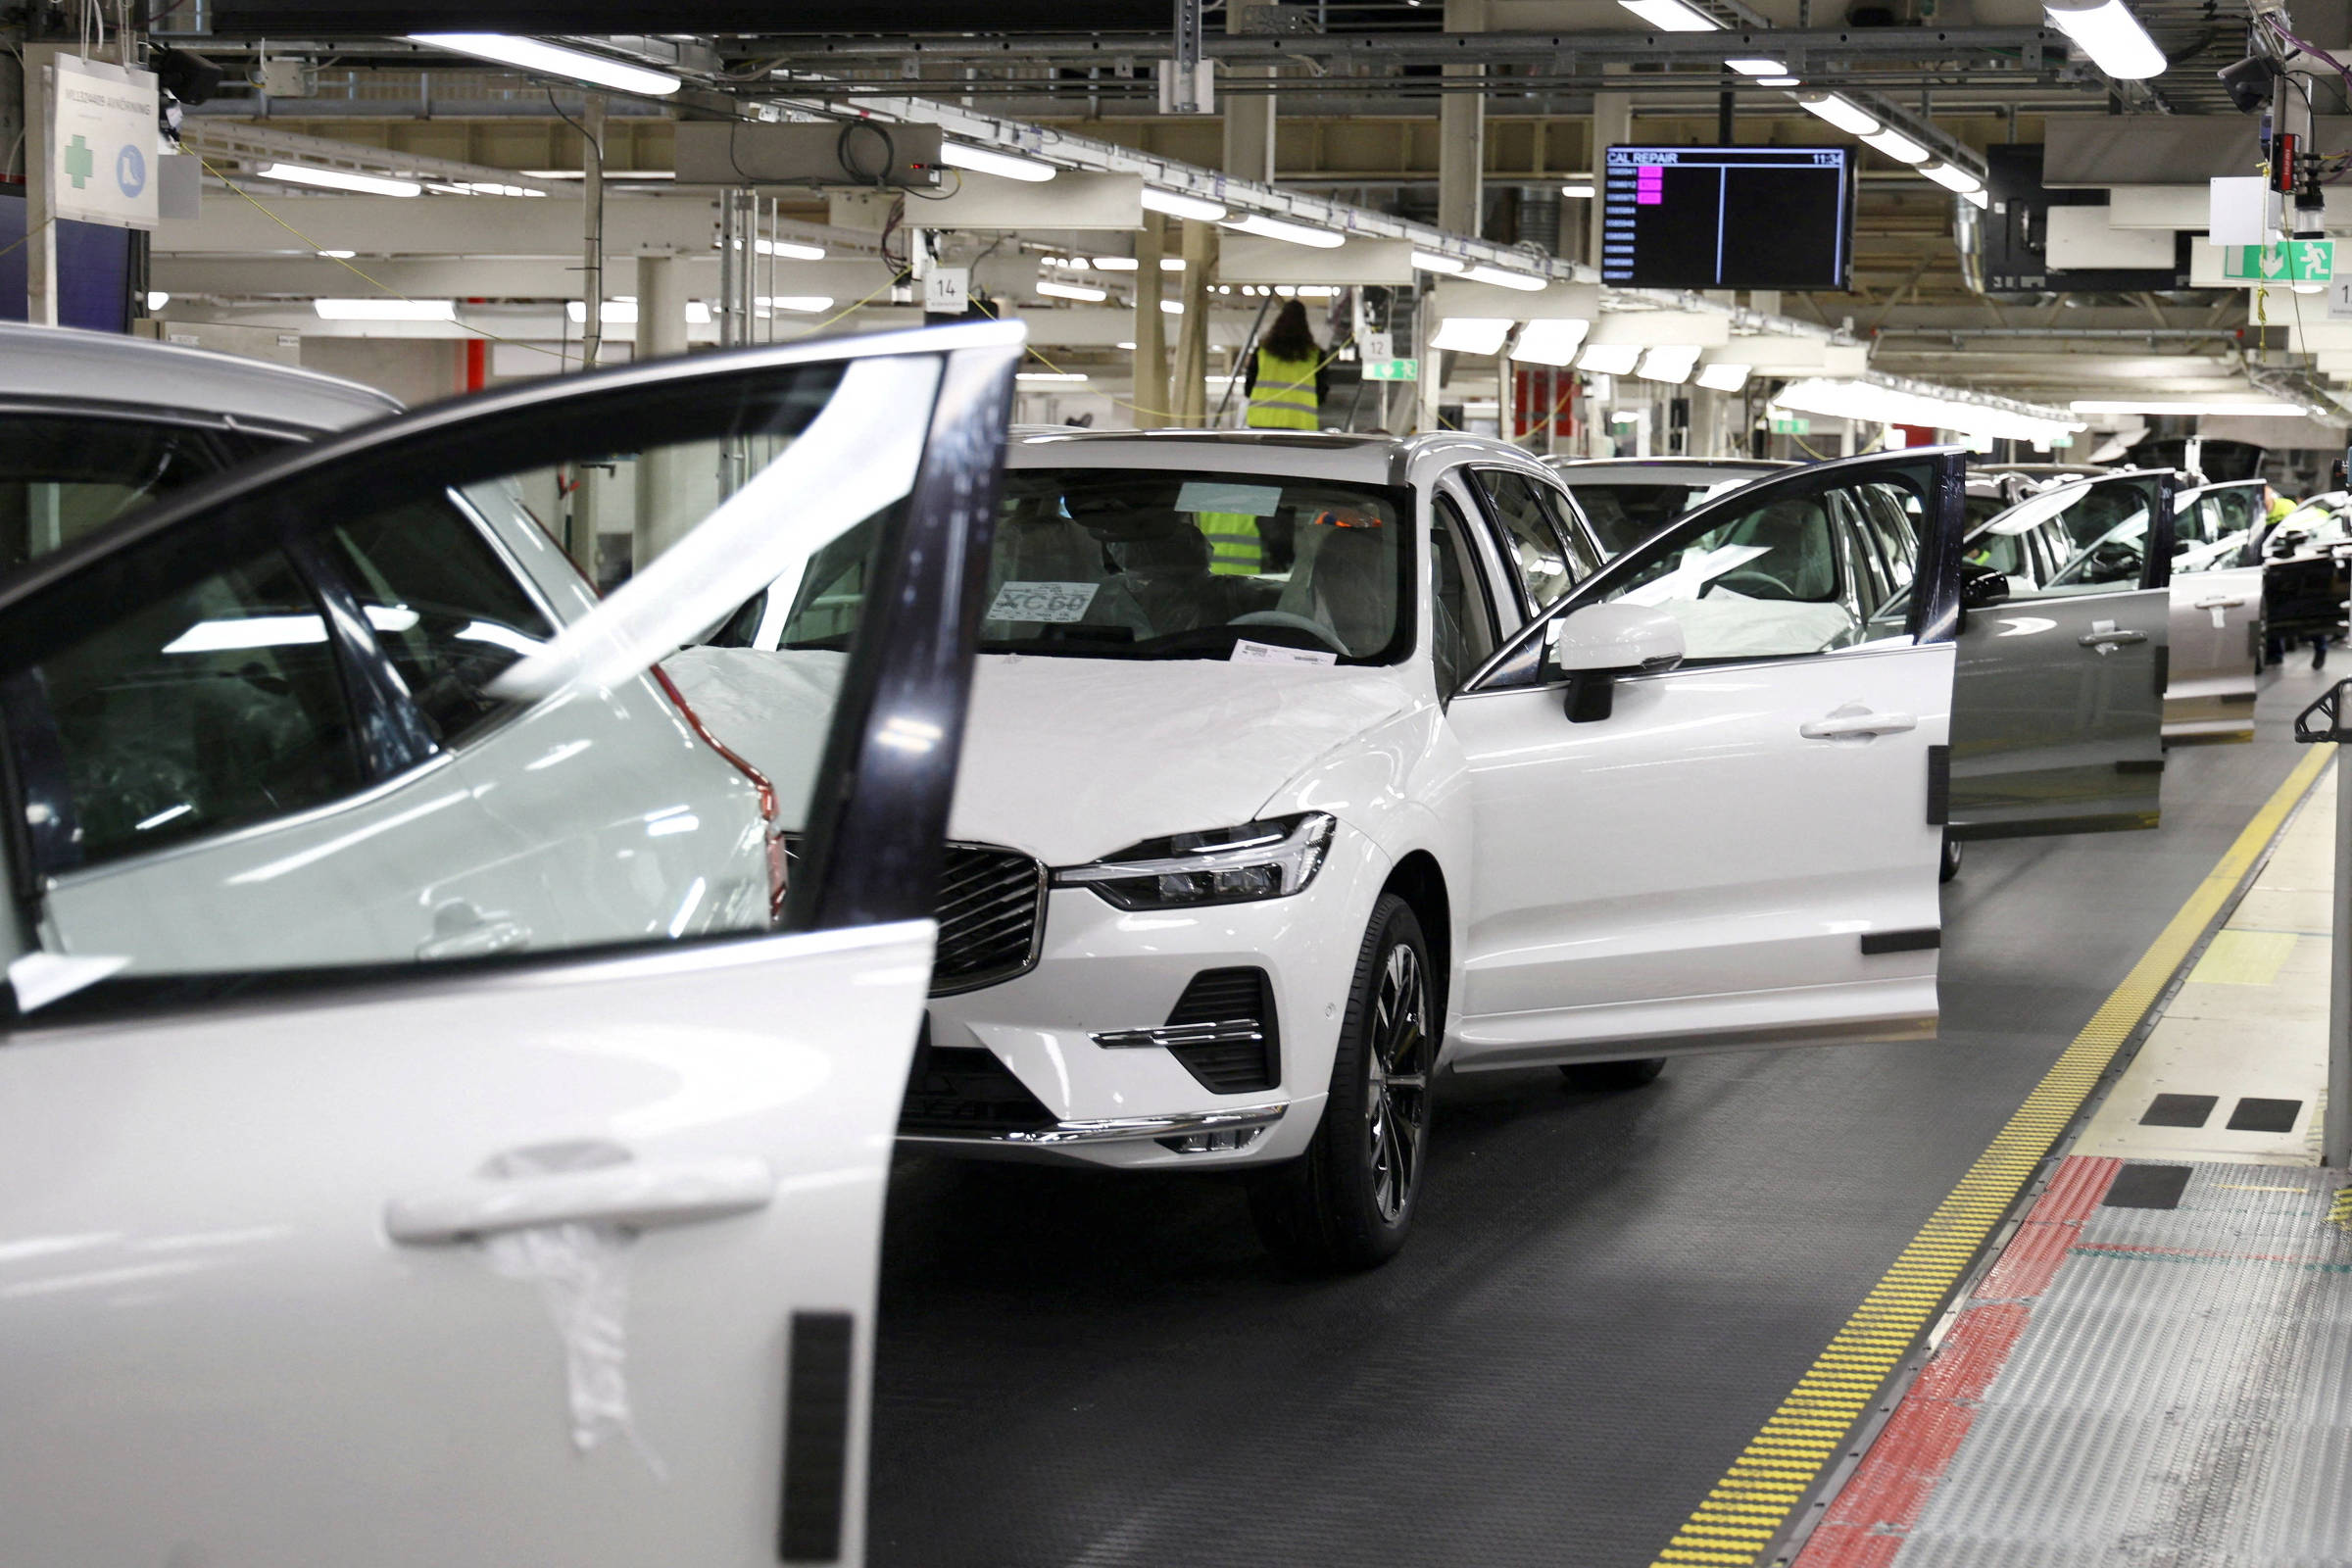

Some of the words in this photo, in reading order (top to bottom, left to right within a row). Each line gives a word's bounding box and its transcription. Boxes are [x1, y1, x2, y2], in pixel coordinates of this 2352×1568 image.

[1607, 152, 1631, 164] CAL
[1633, 152, 1678, 164] REPAIR
[937, 279, 956, 297] 14
[1370, 341, 1384, 355] 12
[1002, 594, 1086, 612] XC60
